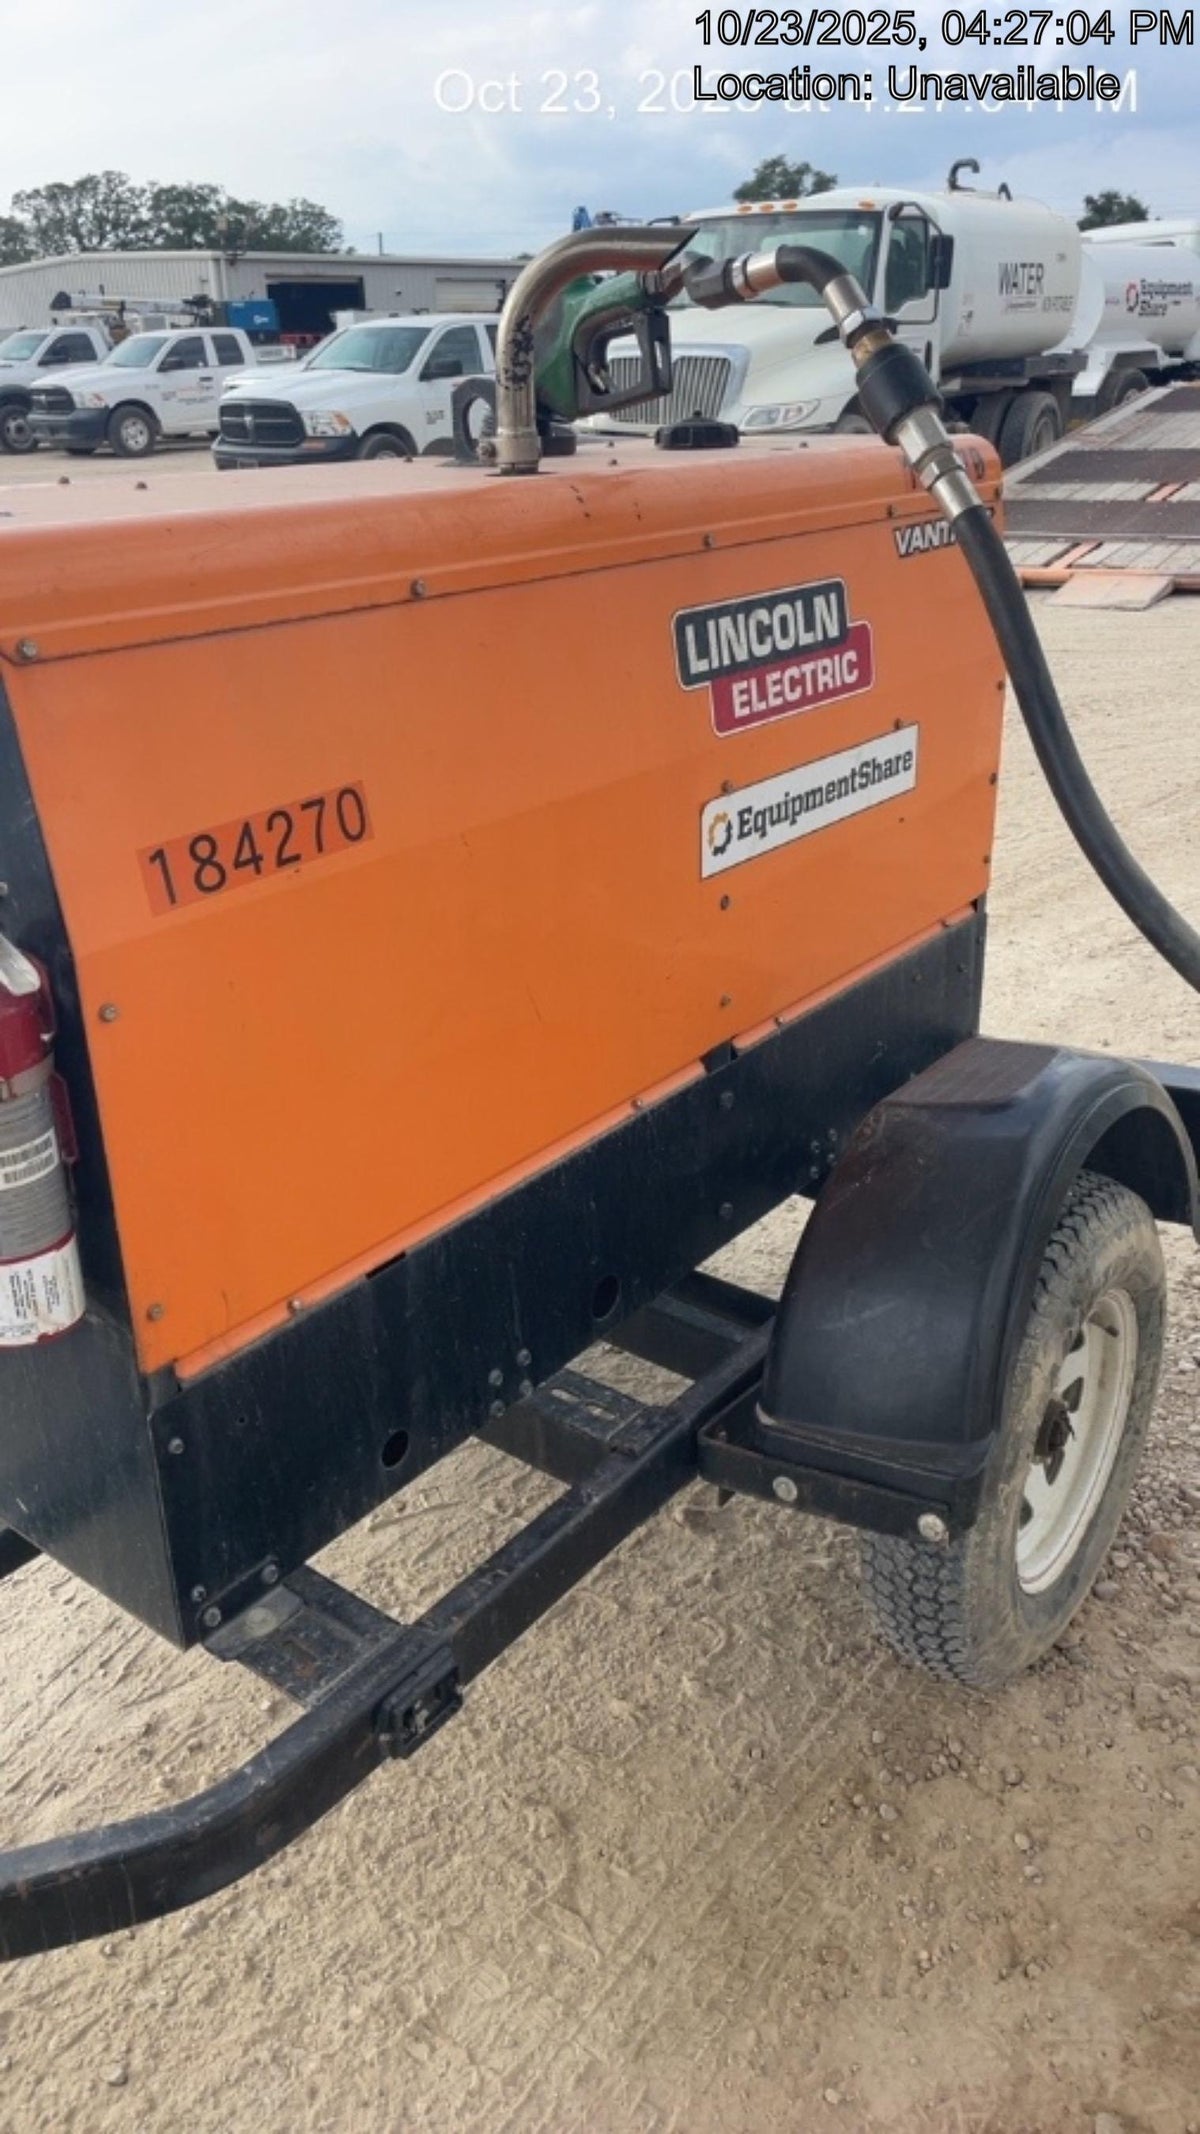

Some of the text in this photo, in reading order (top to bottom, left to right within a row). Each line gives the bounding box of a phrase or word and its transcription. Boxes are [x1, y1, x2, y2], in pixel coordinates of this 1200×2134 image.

[998, 262, 1045, 296] WATER
[684, 592, 841, 675] LINCOLN
[731, 650, 859, 719] ELECTRIC
[736, 749, 913, 841] EquipmentShare
[148, 786, 367, 905] 184270
